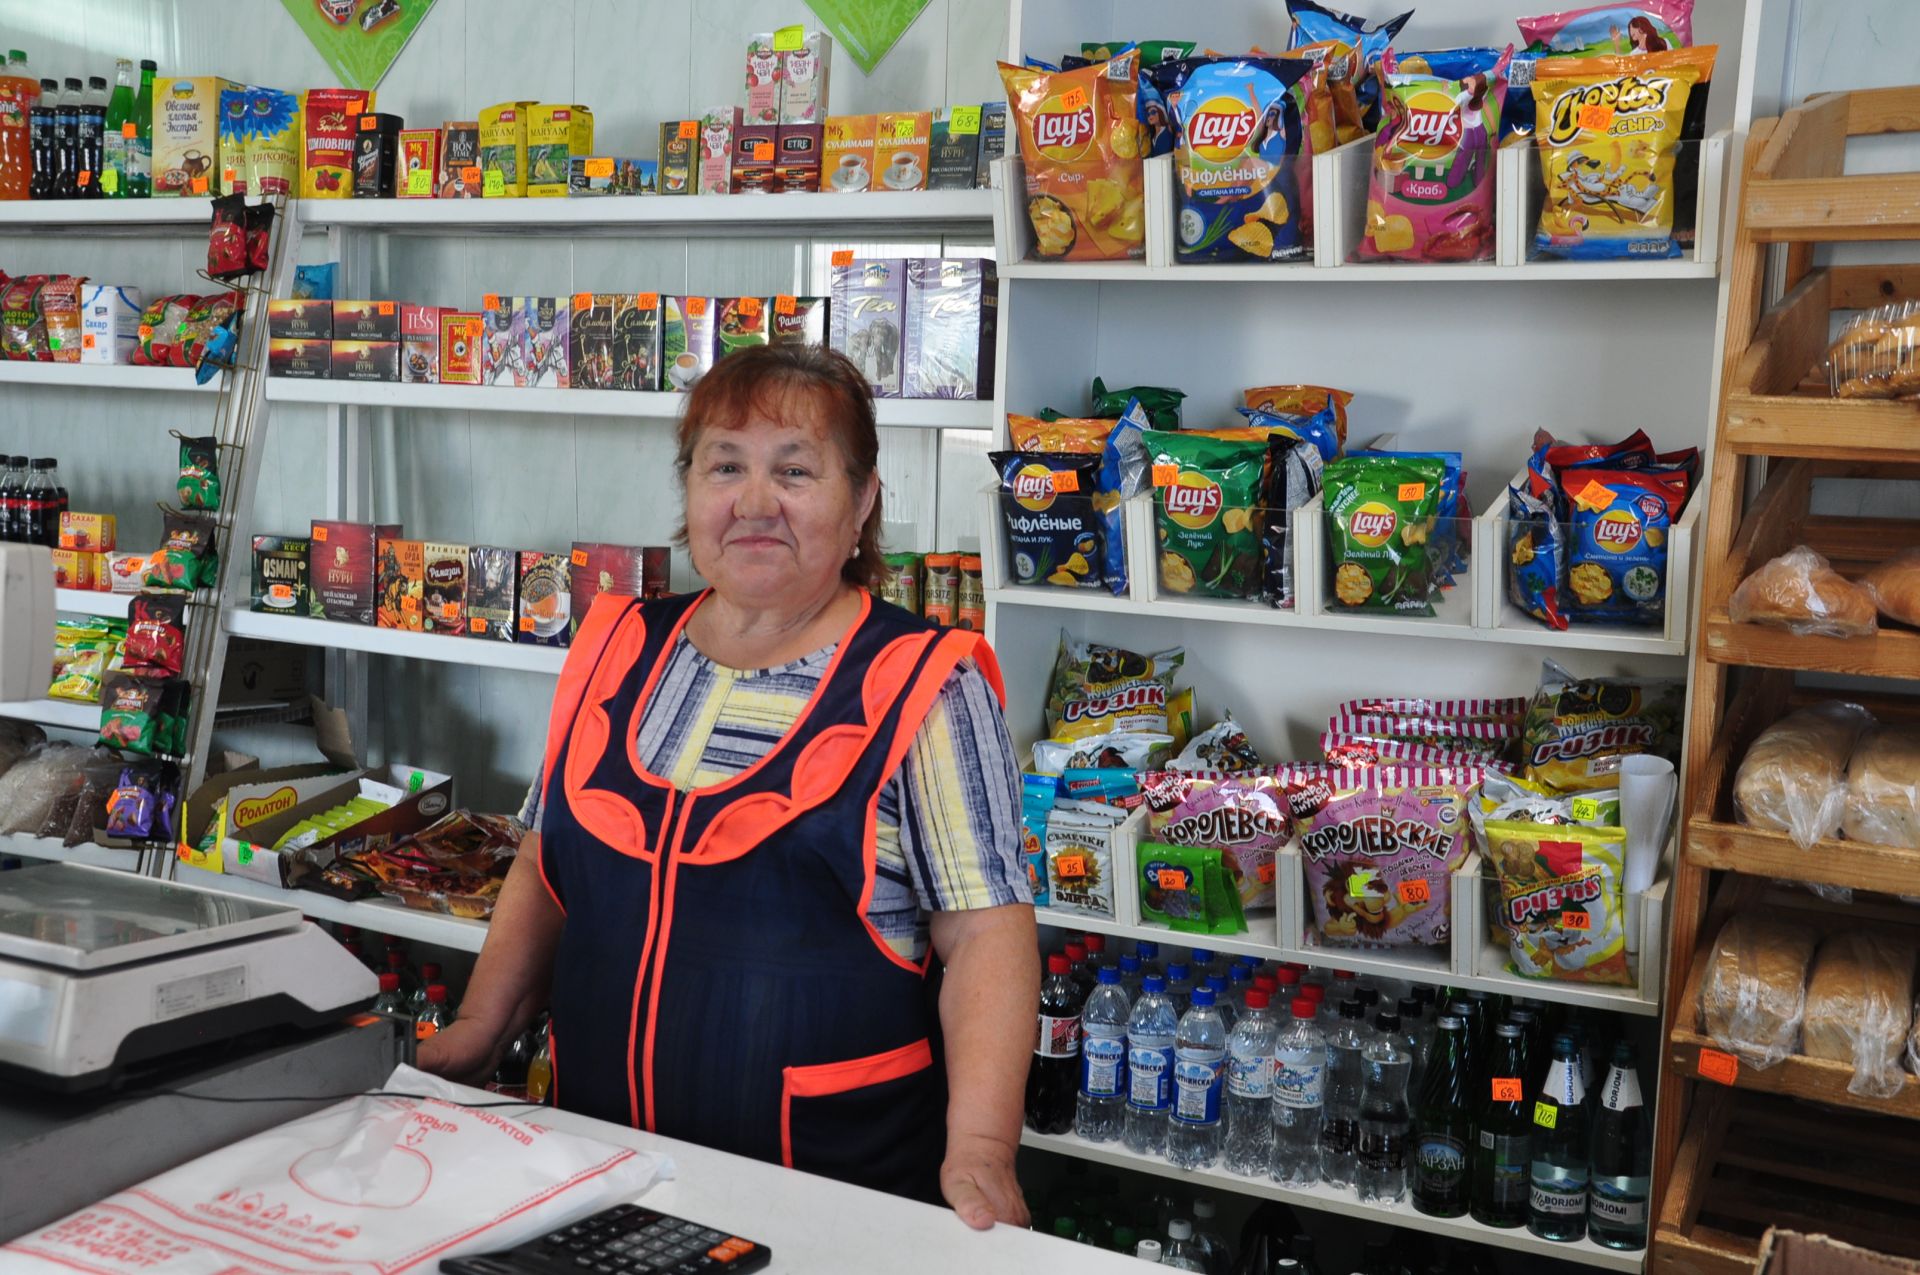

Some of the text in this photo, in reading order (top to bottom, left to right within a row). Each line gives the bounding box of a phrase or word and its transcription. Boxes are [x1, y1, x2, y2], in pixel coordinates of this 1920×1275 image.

[1038, 109, 1091, 148] Lay's
[1192, 111, 1254, 149] Lay's
[452, 142, 473, 152] BON
[1180, 164, 1268, 185] Рифлёные
[407, 312, 434, 329] TESS
[1168, 485, 1218, 516] Lay's
[1353, 513, 1393, 537] Lay's
[1597, 520, 1639, 544] Lay's
[263, 558, 298, 580] OSMAN
[1048, 833, 1105, 848] СЕМЕЧКИ
[1302, 816, 1453, 863] КОРОЛЕВСКИЕ
[1067, 863, 1078, 873] 25
[1406, 886, 1425, 900] 80
[1568, 914, 1583, 927] 30
[1609, 1070, 1623, 1108] BORJOMI
